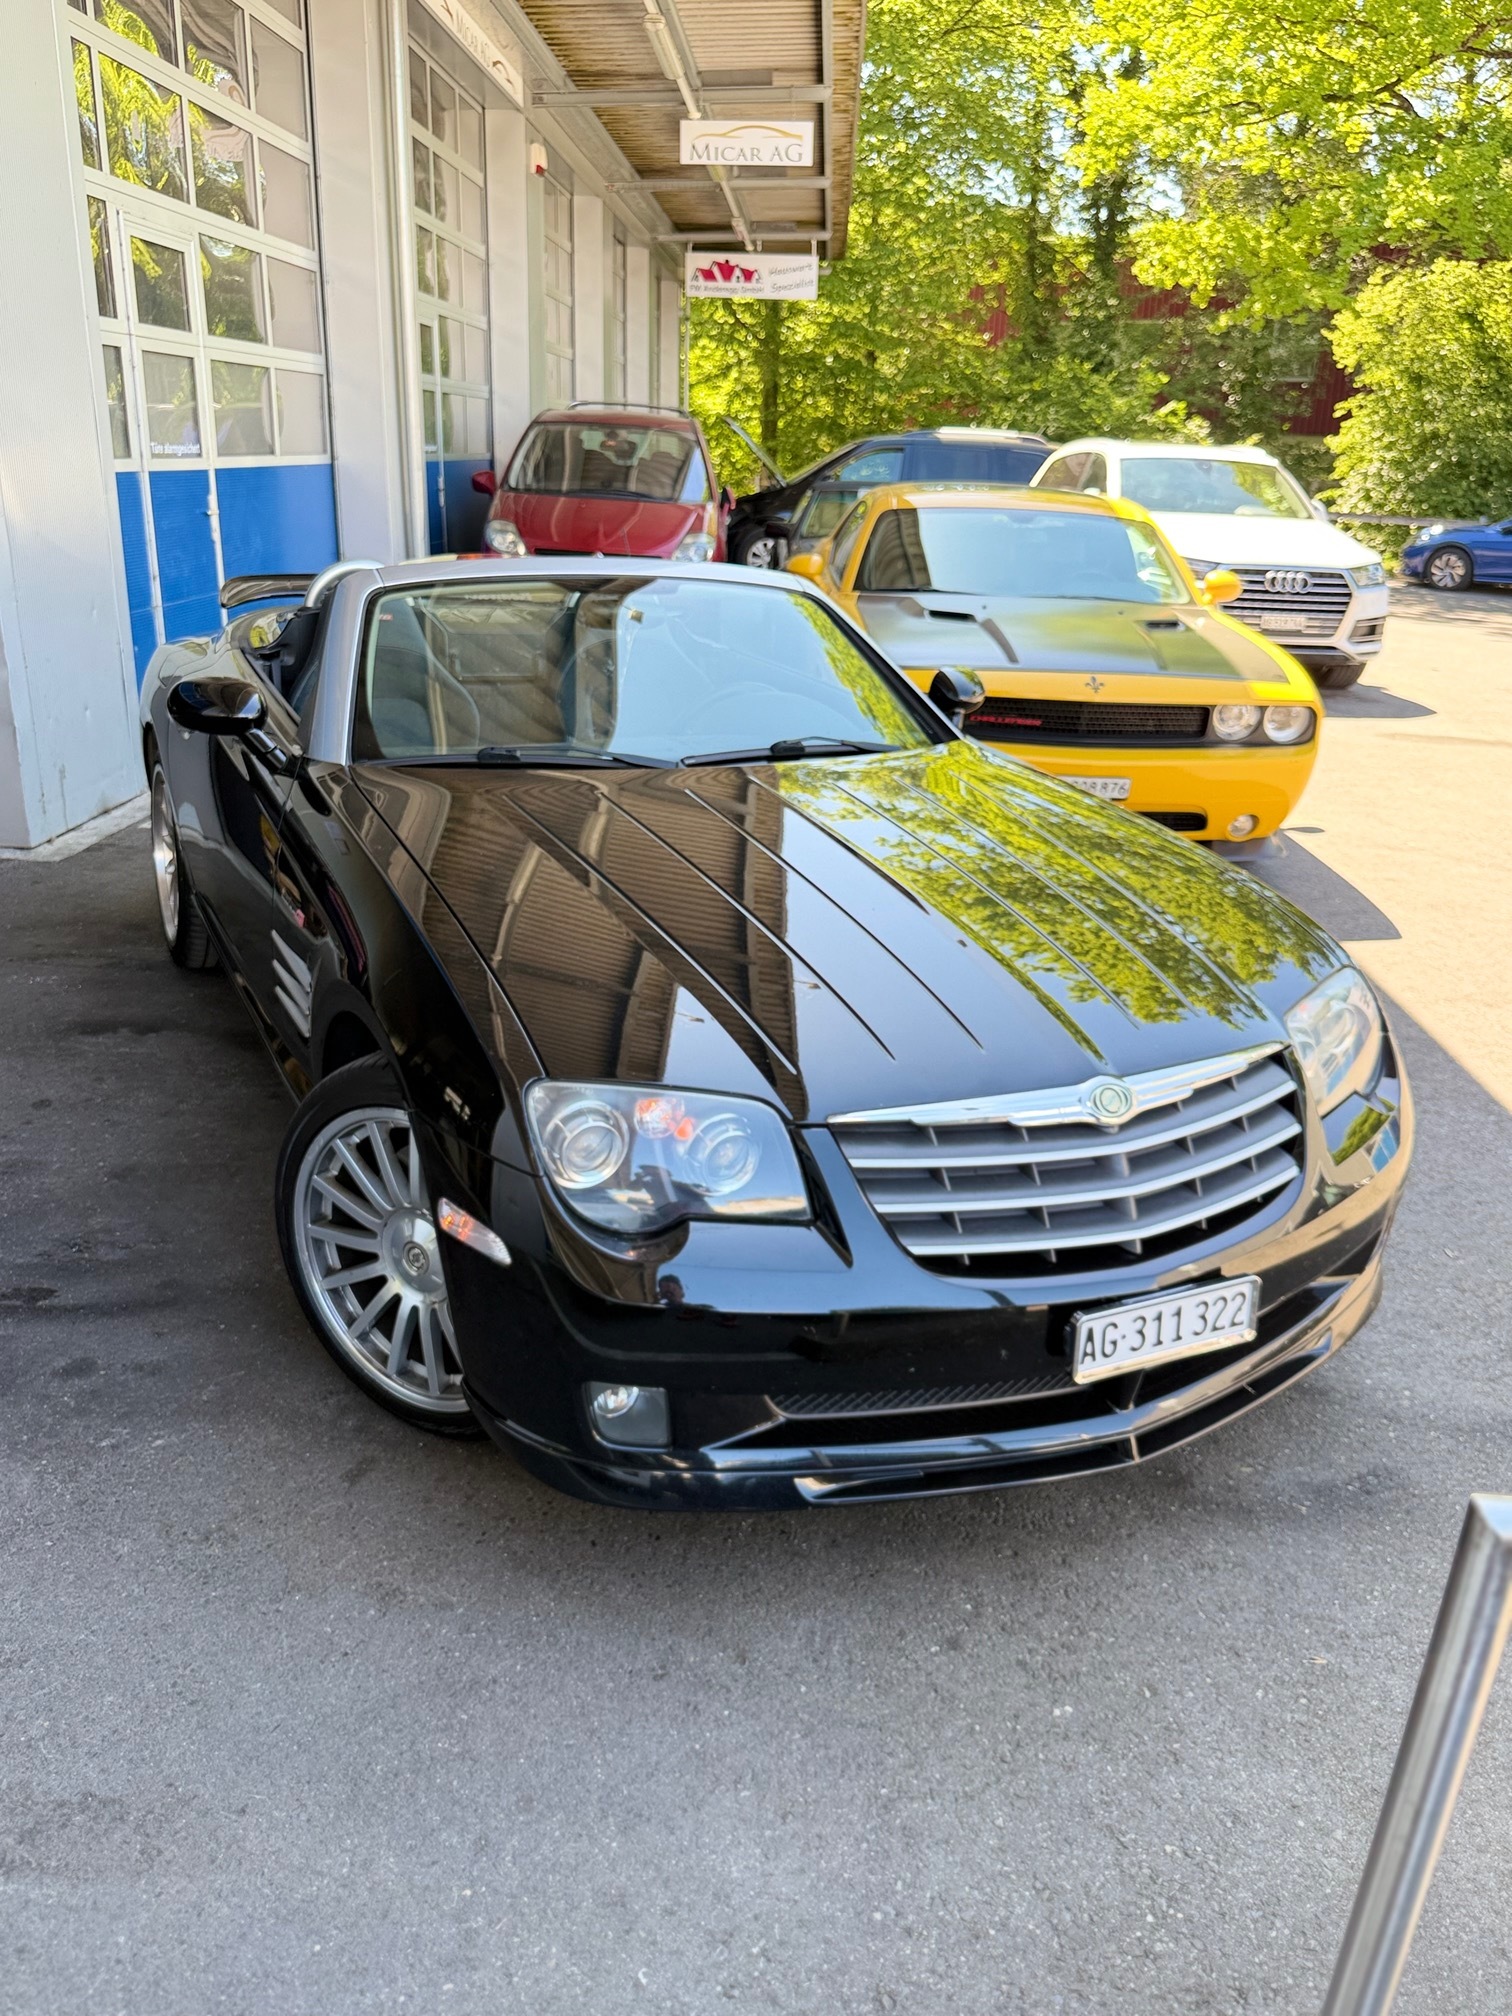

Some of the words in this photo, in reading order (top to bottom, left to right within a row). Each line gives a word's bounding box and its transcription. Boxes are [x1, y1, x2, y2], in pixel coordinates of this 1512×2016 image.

[689, 143, 763, 162] MICAR
[769, 144, 803, 163] AG
[1192, 1292, 1248, 1336] 322
